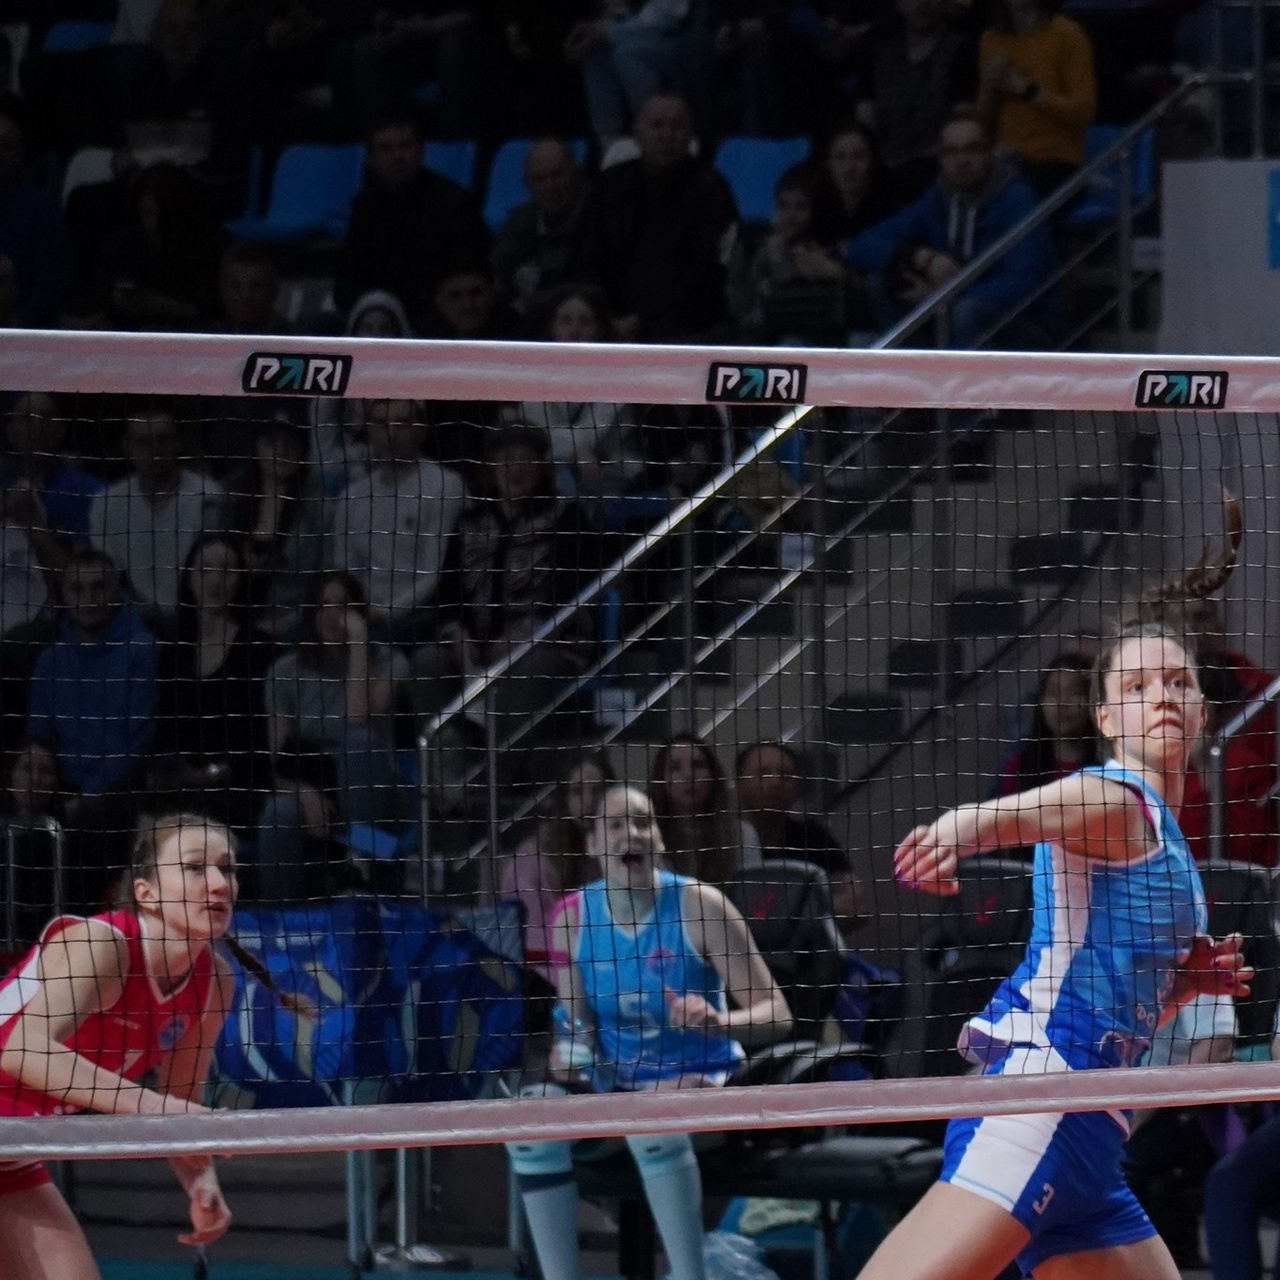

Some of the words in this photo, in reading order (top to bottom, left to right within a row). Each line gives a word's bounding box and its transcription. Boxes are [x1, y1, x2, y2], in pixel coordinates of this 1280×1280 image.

[249, 356, 344, 392] PARI
[715, 367, 800, 400] PARI
[1142, 373, 1221, 405] PARI
